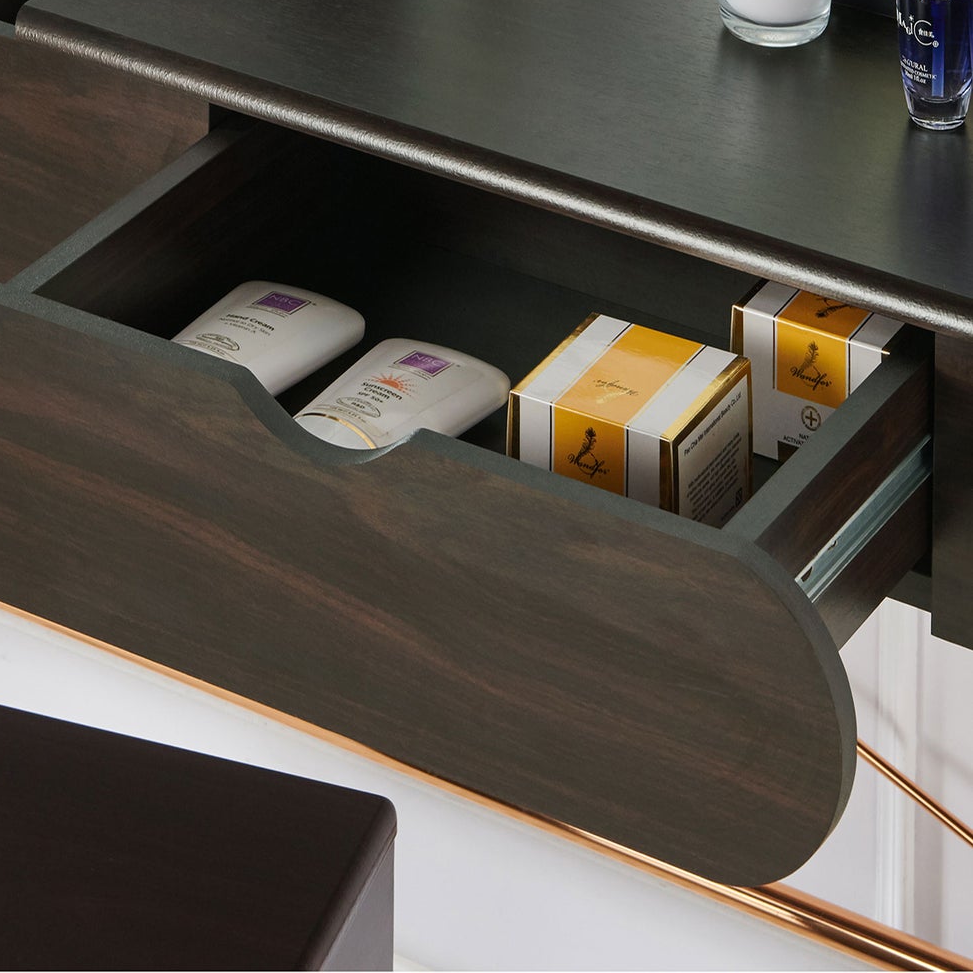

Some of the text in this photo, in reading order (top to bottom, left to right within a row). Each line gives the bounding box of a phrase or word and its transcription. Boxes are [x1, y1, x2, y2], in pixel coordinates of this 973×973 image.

[270, 294, 303, 306] NBC
[226, 313, 275, 332] Hand Cream
[415, 353, 446, 367] NBC
[361, 381, 403, 401] Sunscreen
[364, 386, 390, 401] Cream
